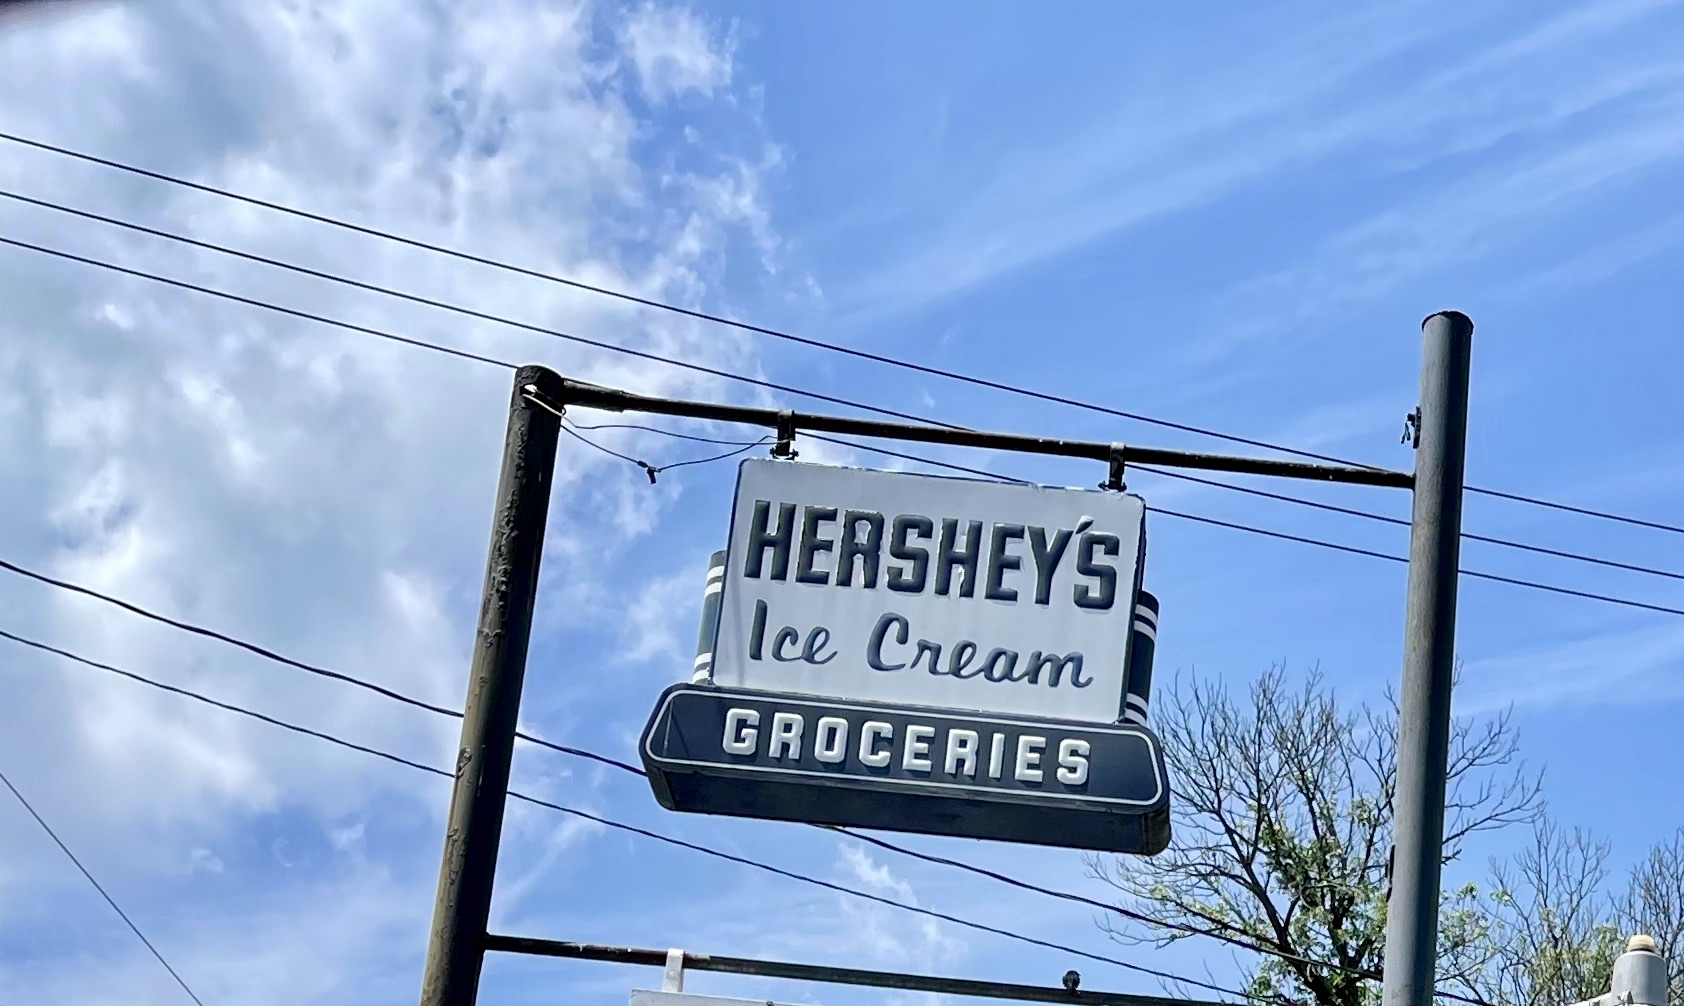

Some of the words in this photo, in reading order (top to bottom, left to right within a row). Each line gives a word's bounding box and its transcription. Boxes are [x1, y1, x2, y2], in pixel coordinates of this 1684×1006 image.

[744, 499, 1121, 610] HERSHEY'S
[749, 600, 838, 665] Ice
[866, 612, 1094, 688] Cream
[722, 707, 1091, 786] GROCERIES
